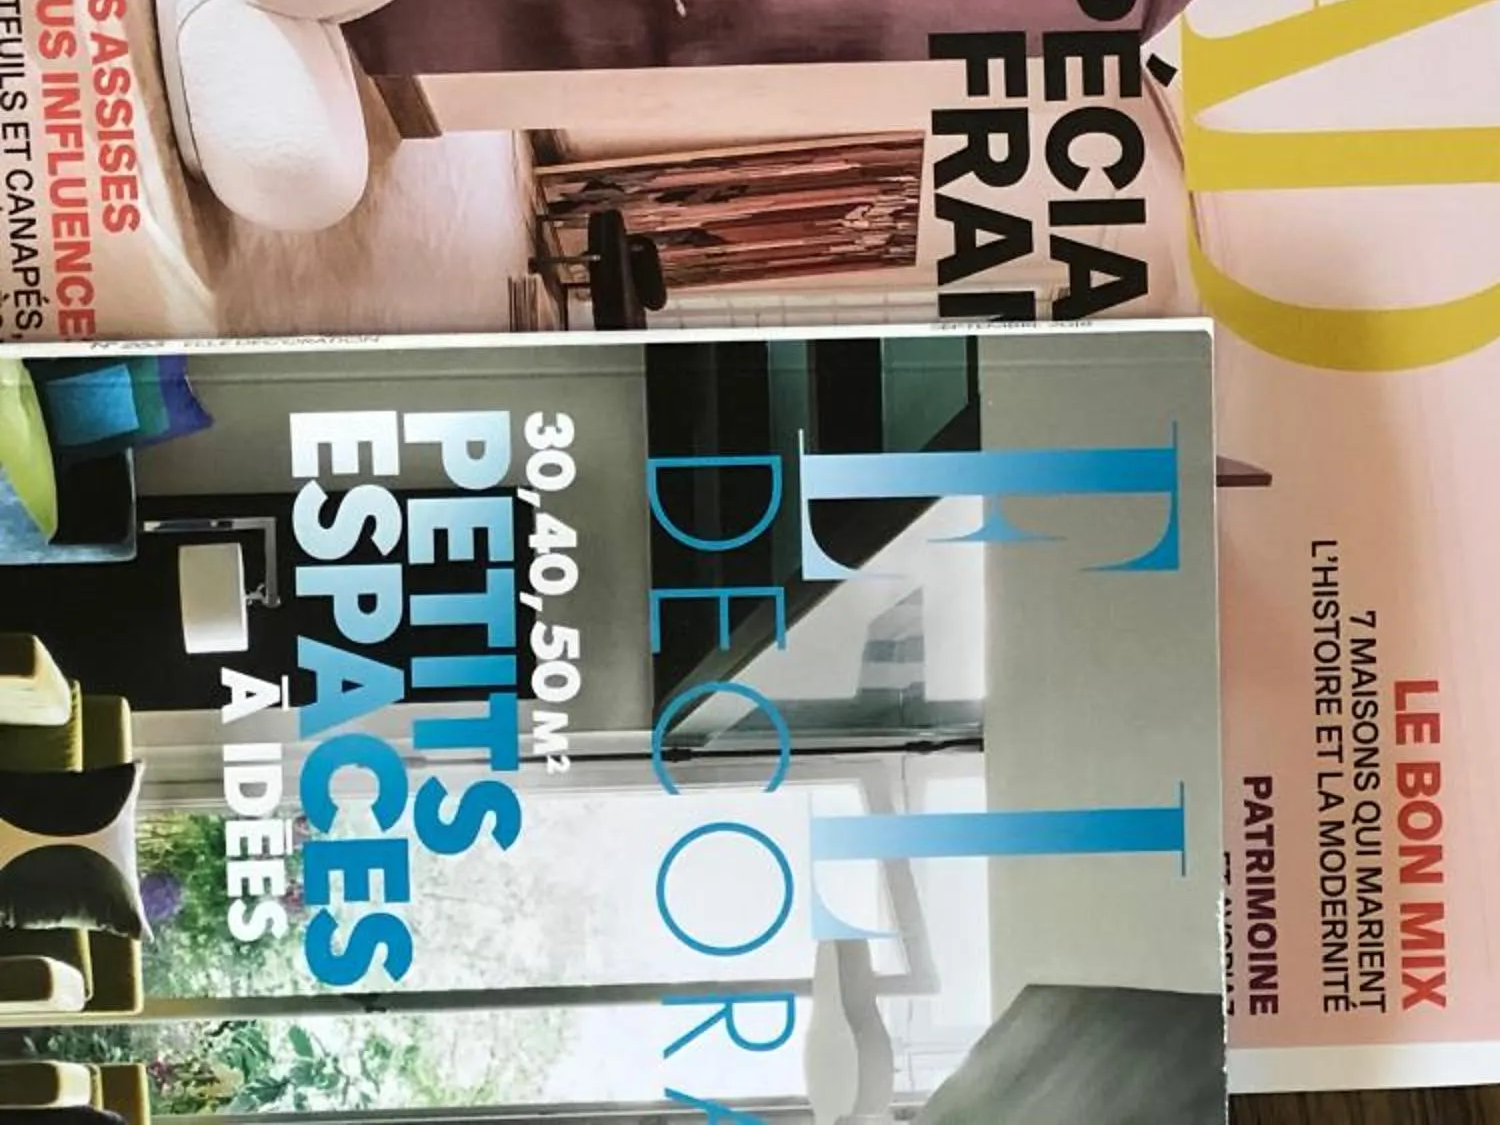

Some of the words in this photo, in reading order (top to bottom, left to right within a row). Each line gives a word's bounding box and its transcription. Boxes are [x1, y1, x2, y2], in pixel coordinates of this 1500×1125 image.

[2, 122, 33, 163] ET
[42, 72, 97, 342] INFLUENCE
[90, 32, 141, 234] ASSISES
[6, 169, 50, 340] CANAPÉS,
[403, 411, 522, 856] PETITS
[1349, 610, 1378, 628] 7
[289, 411, 415, 987] ESPACES
[1315, 725, 1345, 765] ET
[1349, 638, 1382, 792] MAISONS
[1393, 678, 1441, 746] LE
[1317, 771, 1347, 812] LA
[1351, 799, 1383, 857] QUI
[1396, 761, 1445, 885] BON
[1243, 775, 1279, 1016] PATRIMOINE
[1319, 820, 1358, 1014] MODERNITÉ
[1356, 866, 1387, 1014] MARIENT
[1398, 901, 1449, 1012] MIX
